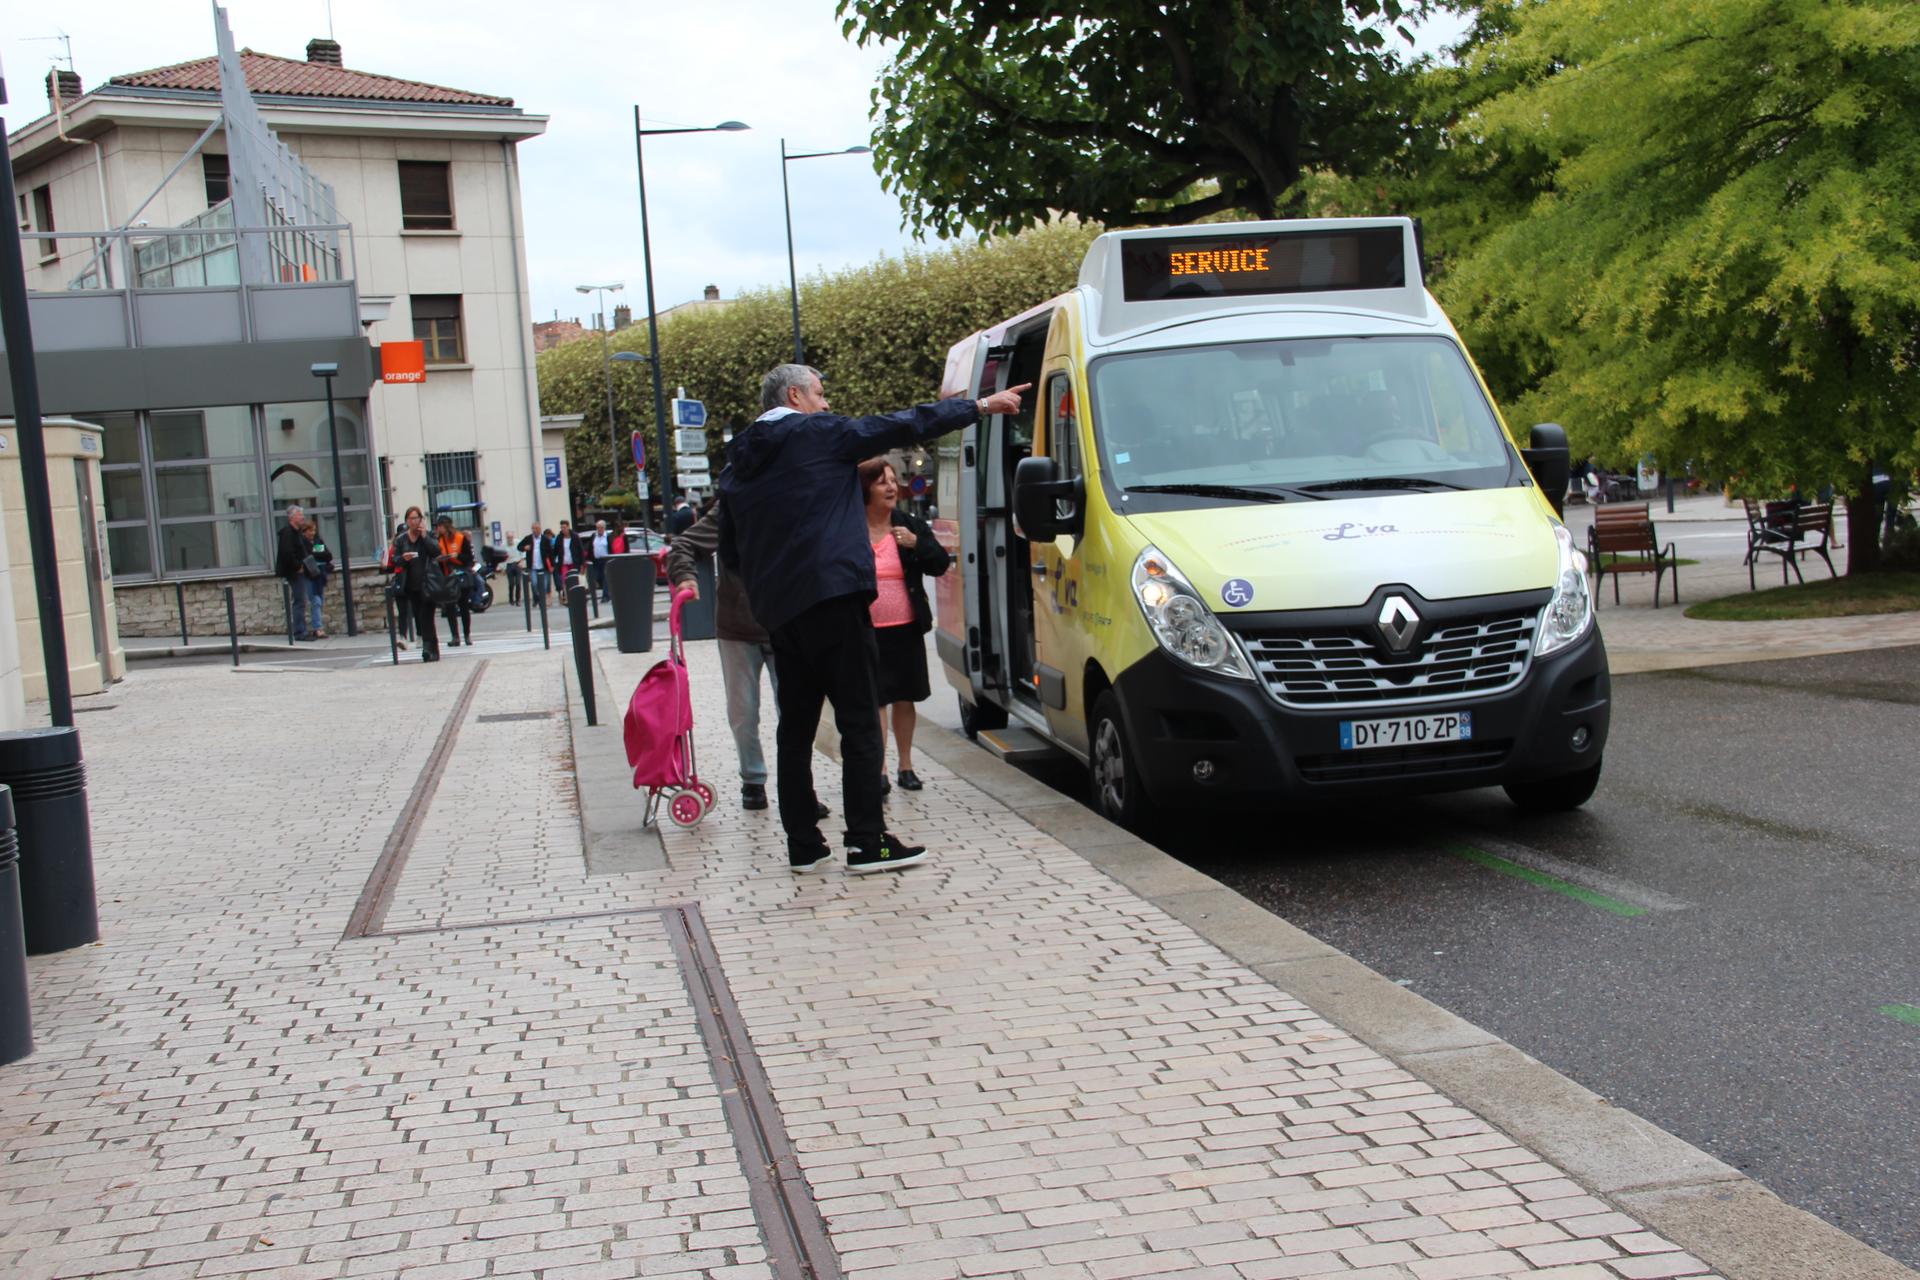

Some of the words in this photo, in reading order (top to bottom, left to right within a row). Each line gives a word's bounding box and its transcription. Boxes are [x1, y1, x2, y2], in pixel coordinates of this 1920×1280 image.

[1171, 248, 1270, 275] SERVICE
[385, 372, 421, 382] orange
[1323, 522, 1399, 541] L'va
[1355, 717, 1458, 746] DY-710-ZP
[1460, 725, 1471, 737] 38
